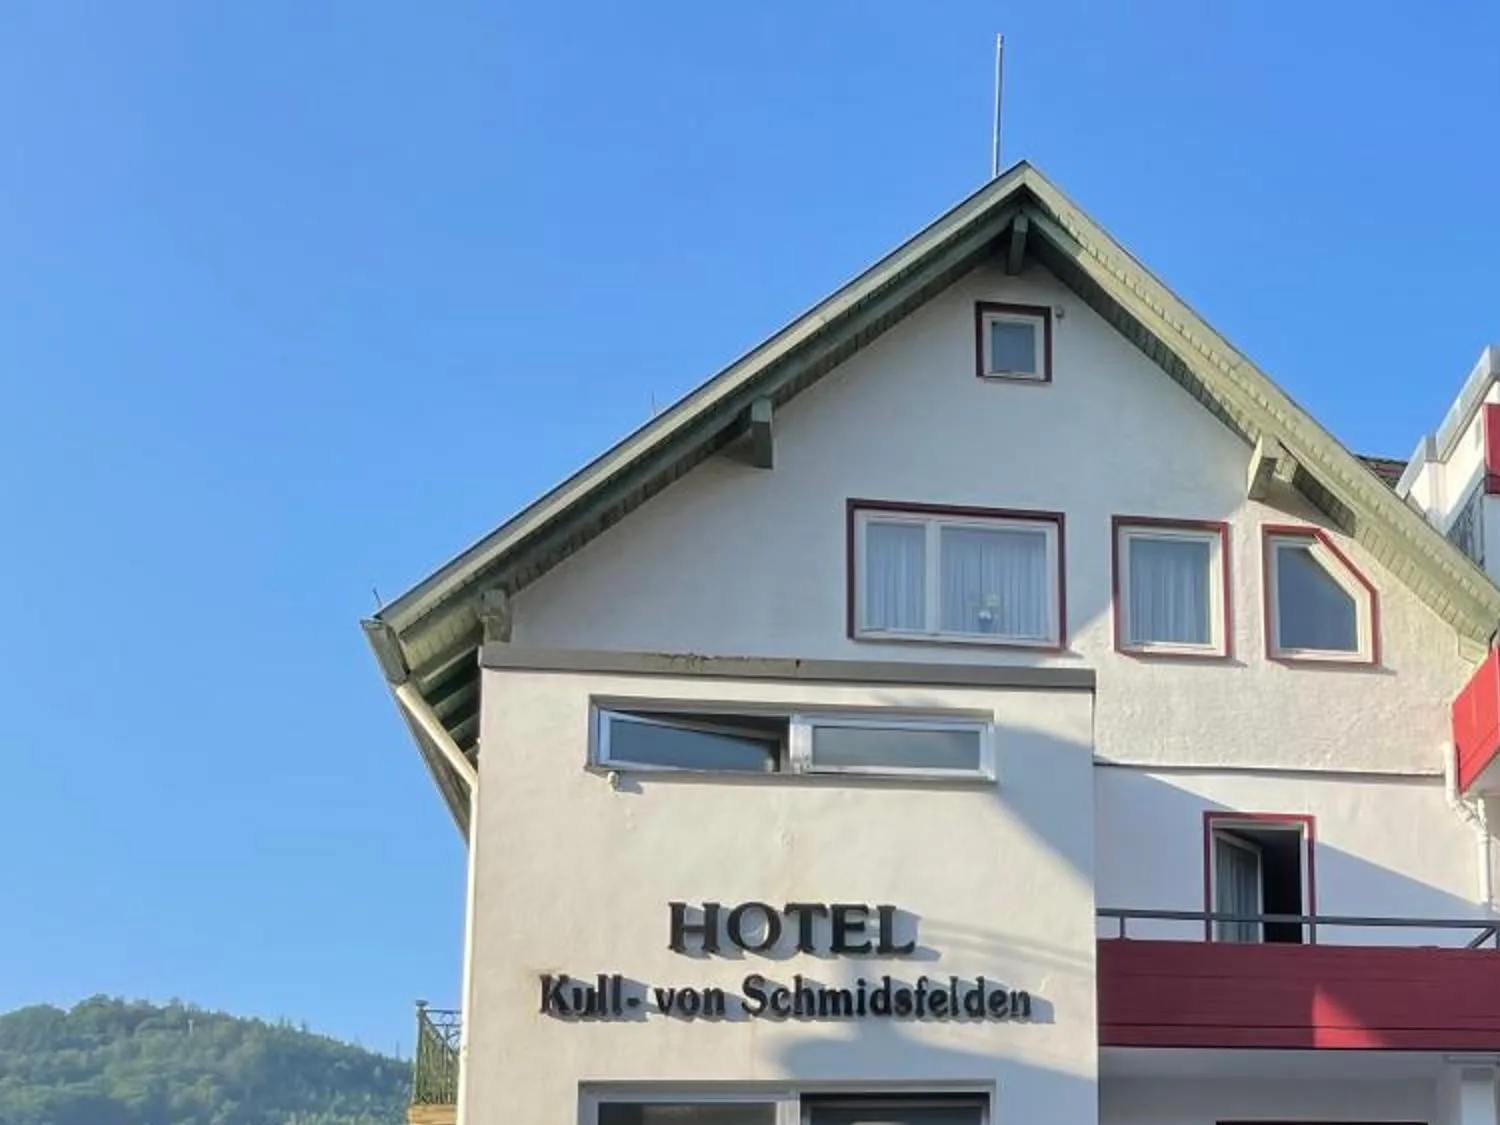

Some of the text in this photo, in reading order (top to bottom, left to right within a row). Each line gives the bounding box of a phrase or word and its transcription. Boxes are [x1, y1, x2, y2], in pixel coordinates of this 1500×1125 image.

[668, 901, 916, 955] HOTEL
[539, 973, 1032, 1018] Kull- von Schmidsfelden
